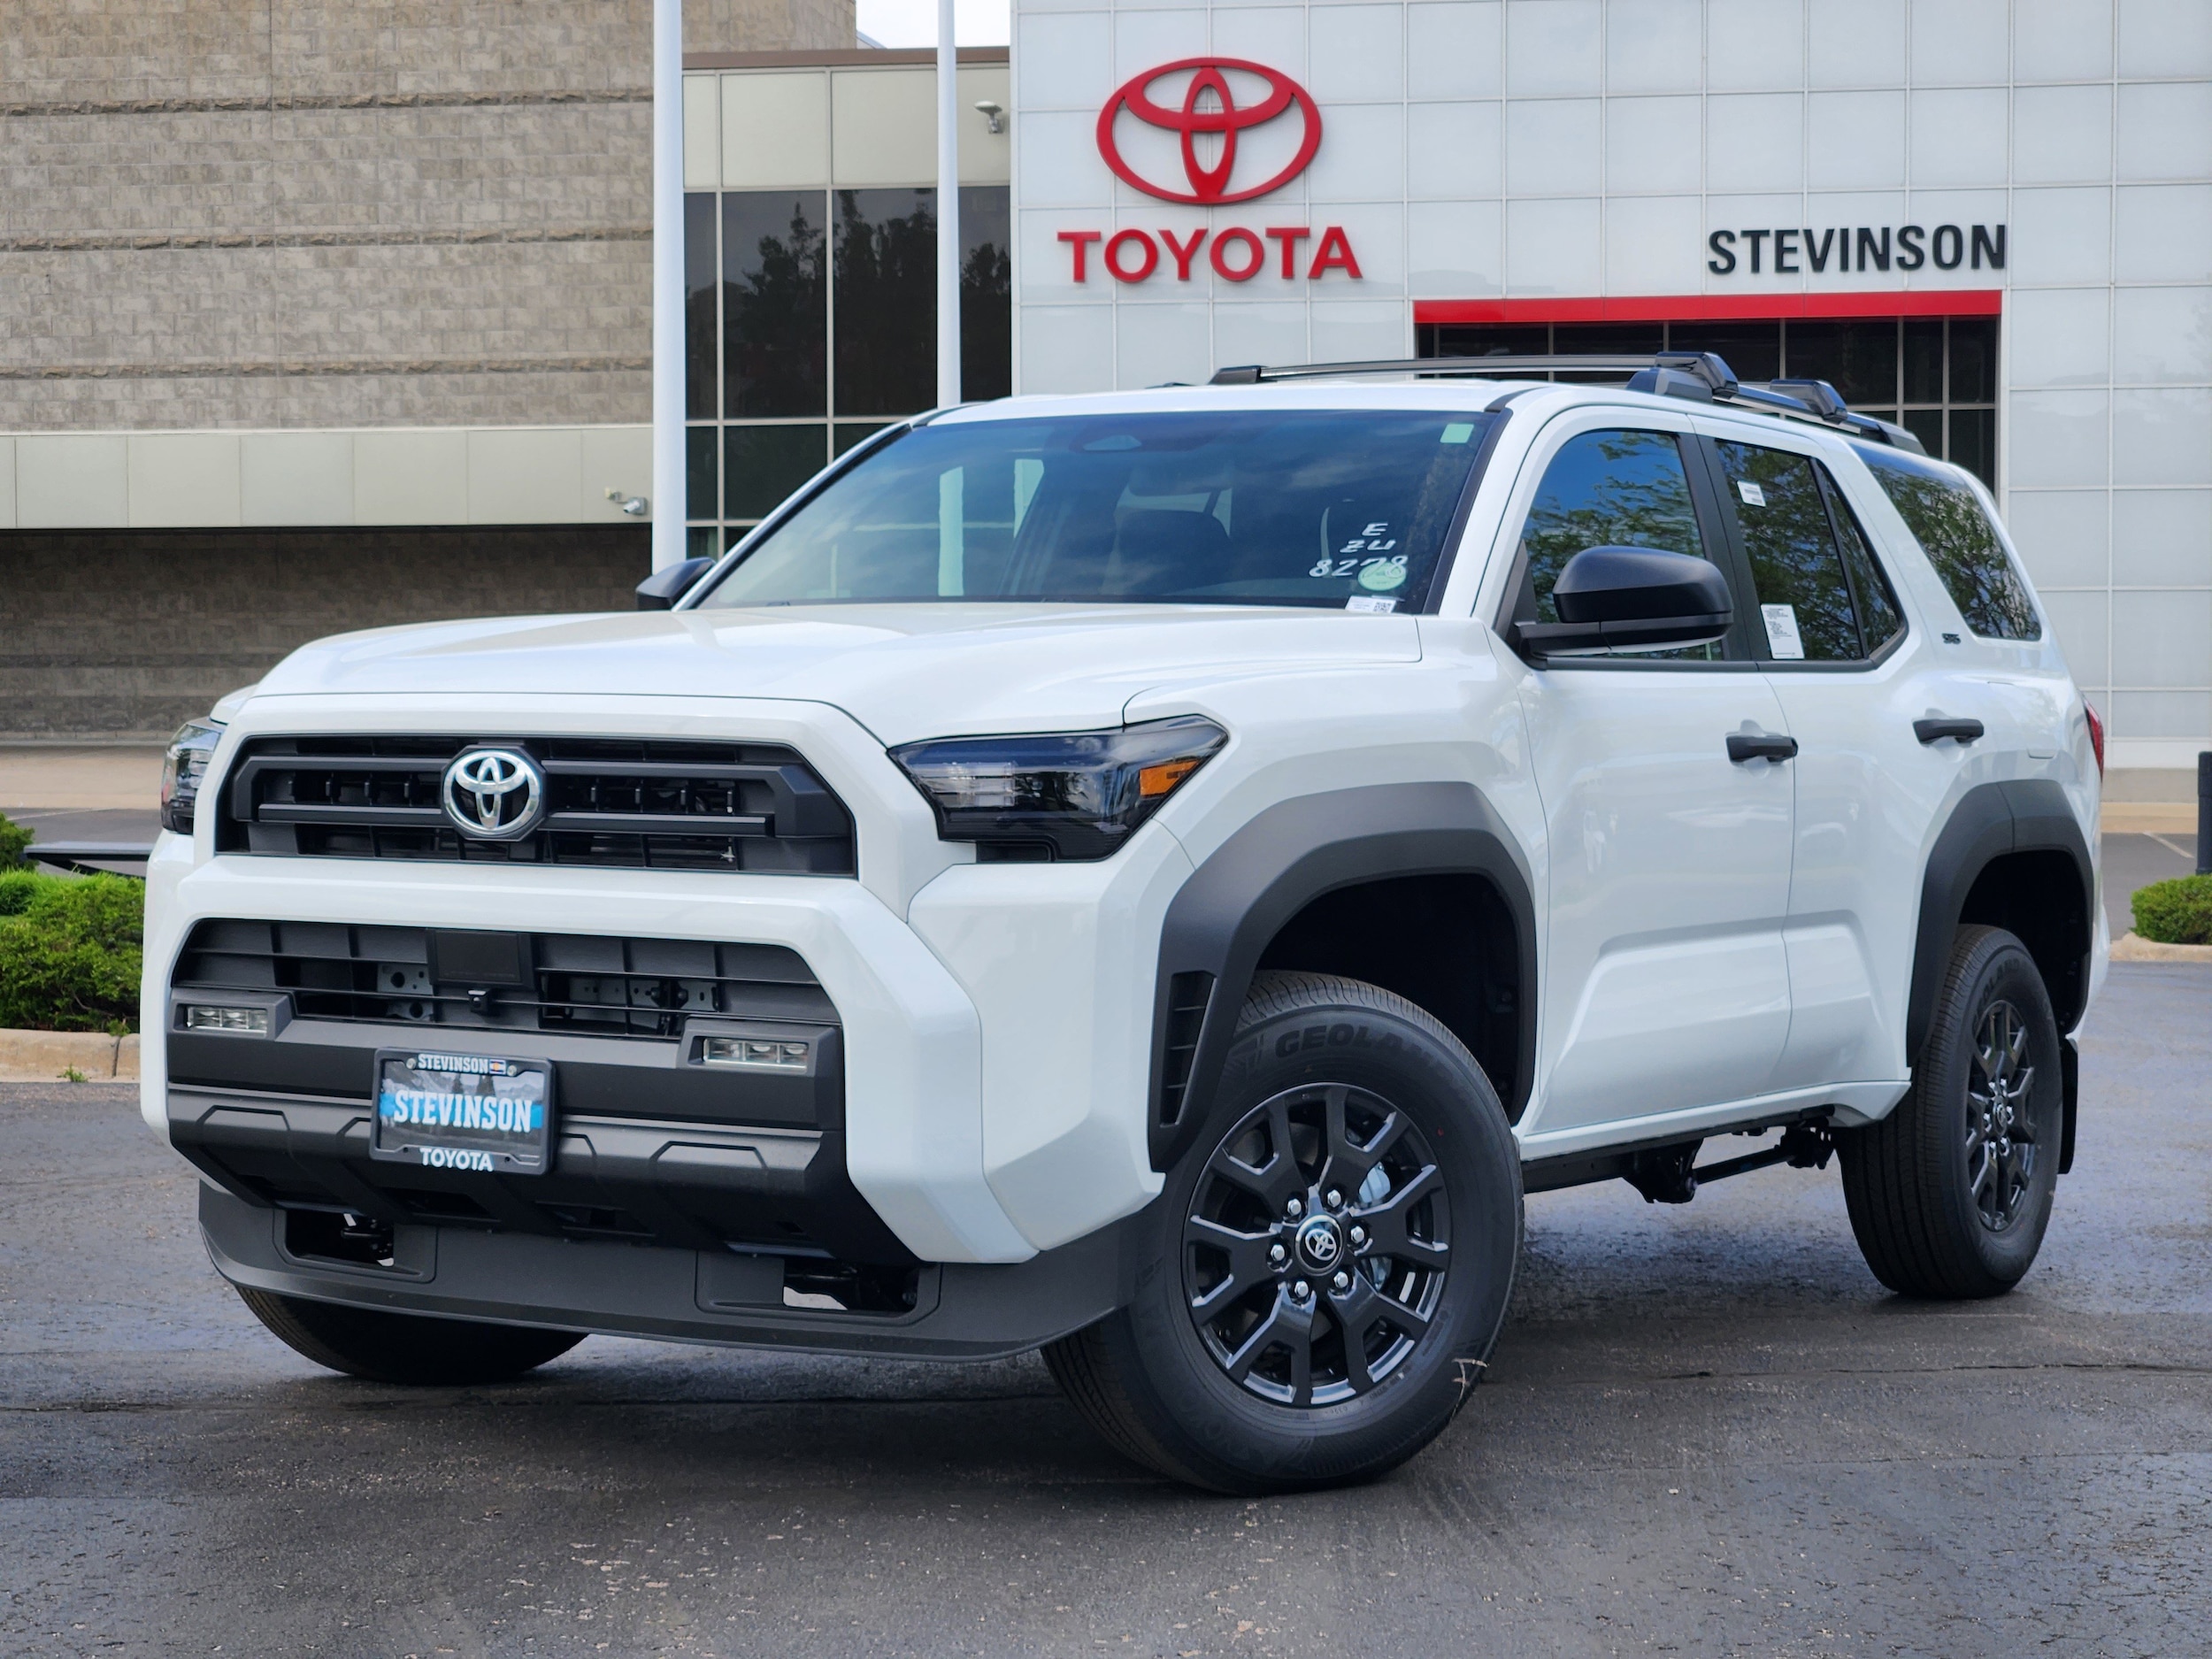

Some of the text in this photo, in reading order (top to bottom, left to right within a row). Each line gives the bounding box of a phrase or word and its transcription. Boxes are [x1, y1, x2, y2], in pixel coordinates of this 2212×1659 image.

[1057, 226, 1362, 283] TOYOTA
[1709, 223, 2007, 276] STEVINSON
[1361, 522, 1389, 536] E
[1308, 554, 1409, 578] 8278
[1274, 1023, 1433, 1067] GEOLA
[418, 1054, 489, 1073] STEVINSON
[393, 1089, 534, 1133] STEVINSON
[419, 1148, 495, 1172] TOYOTA
